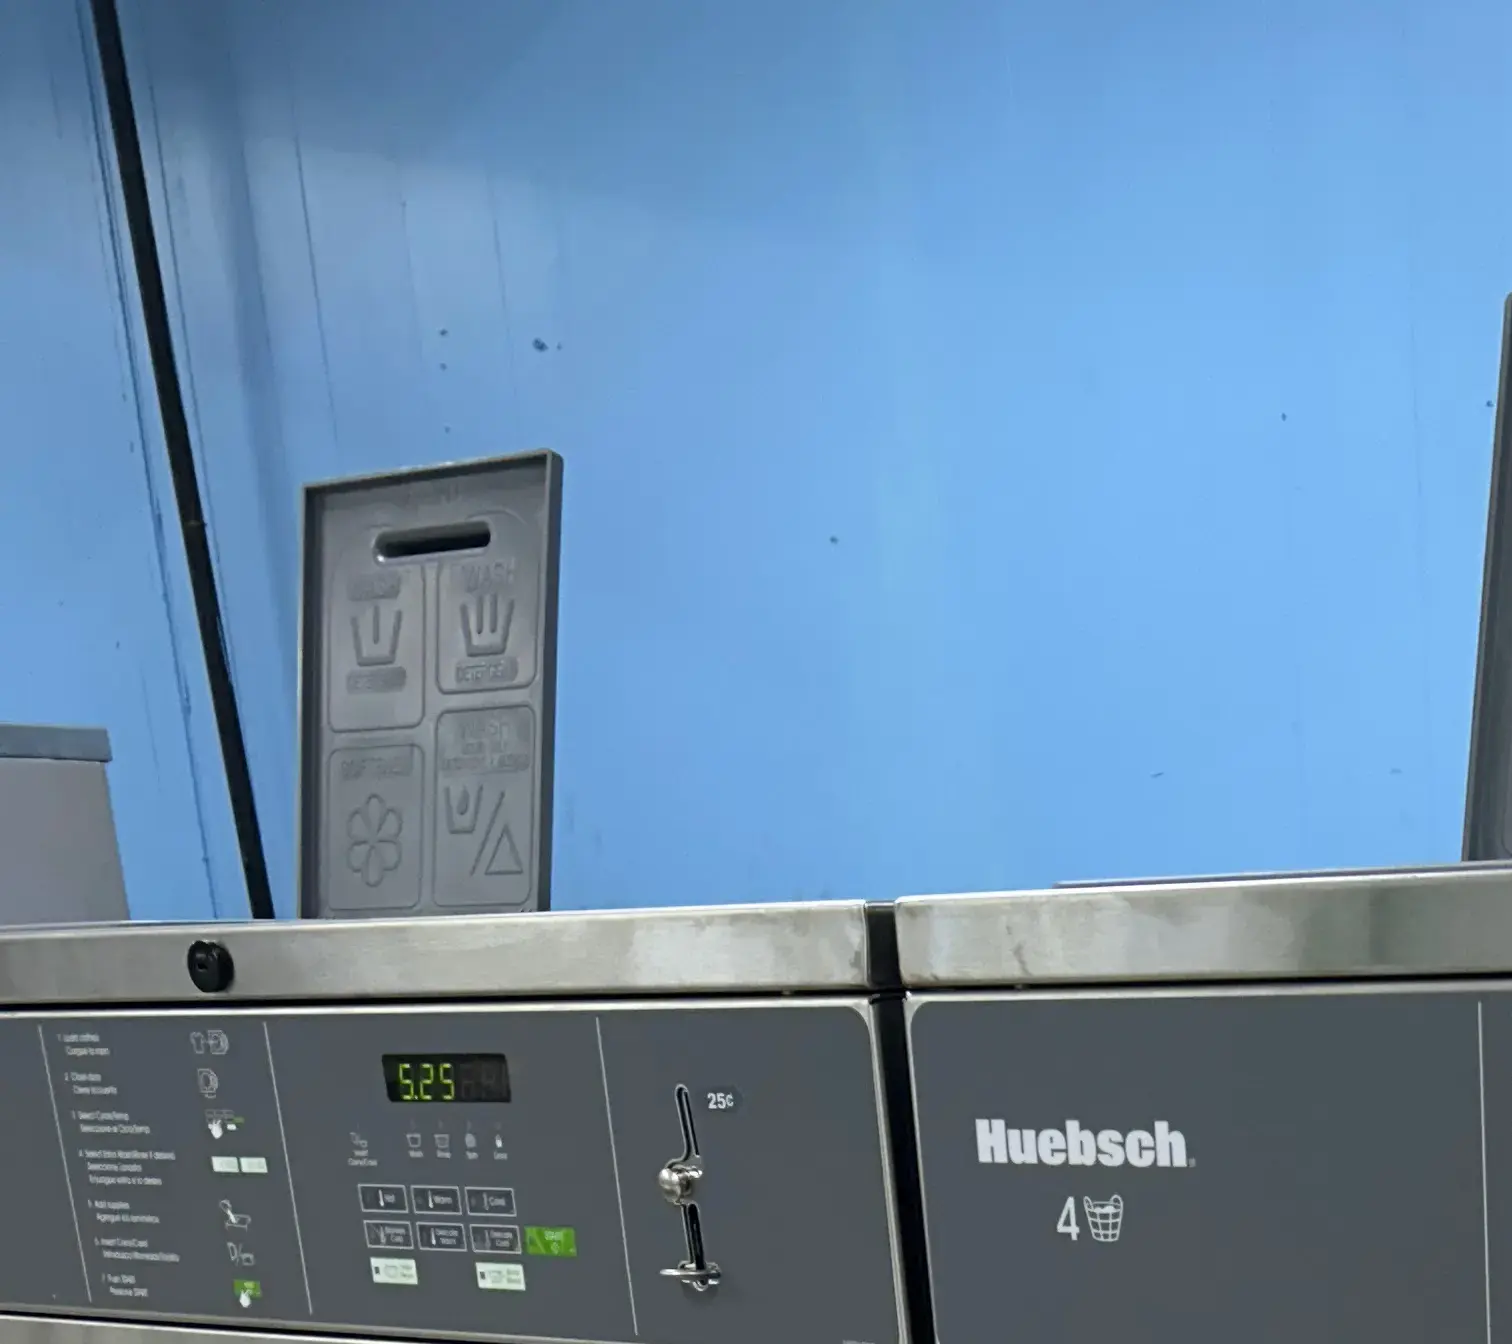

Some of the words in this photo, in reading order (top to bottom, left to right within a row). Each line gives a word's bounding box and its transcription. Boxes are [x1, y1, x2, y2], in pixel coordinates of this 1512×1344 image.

[399, 1063, 455, 1100] 5.25
[975, 1118, 1188, 1168] Huebsch
[1057, 1196, 1081, 1241] 4
